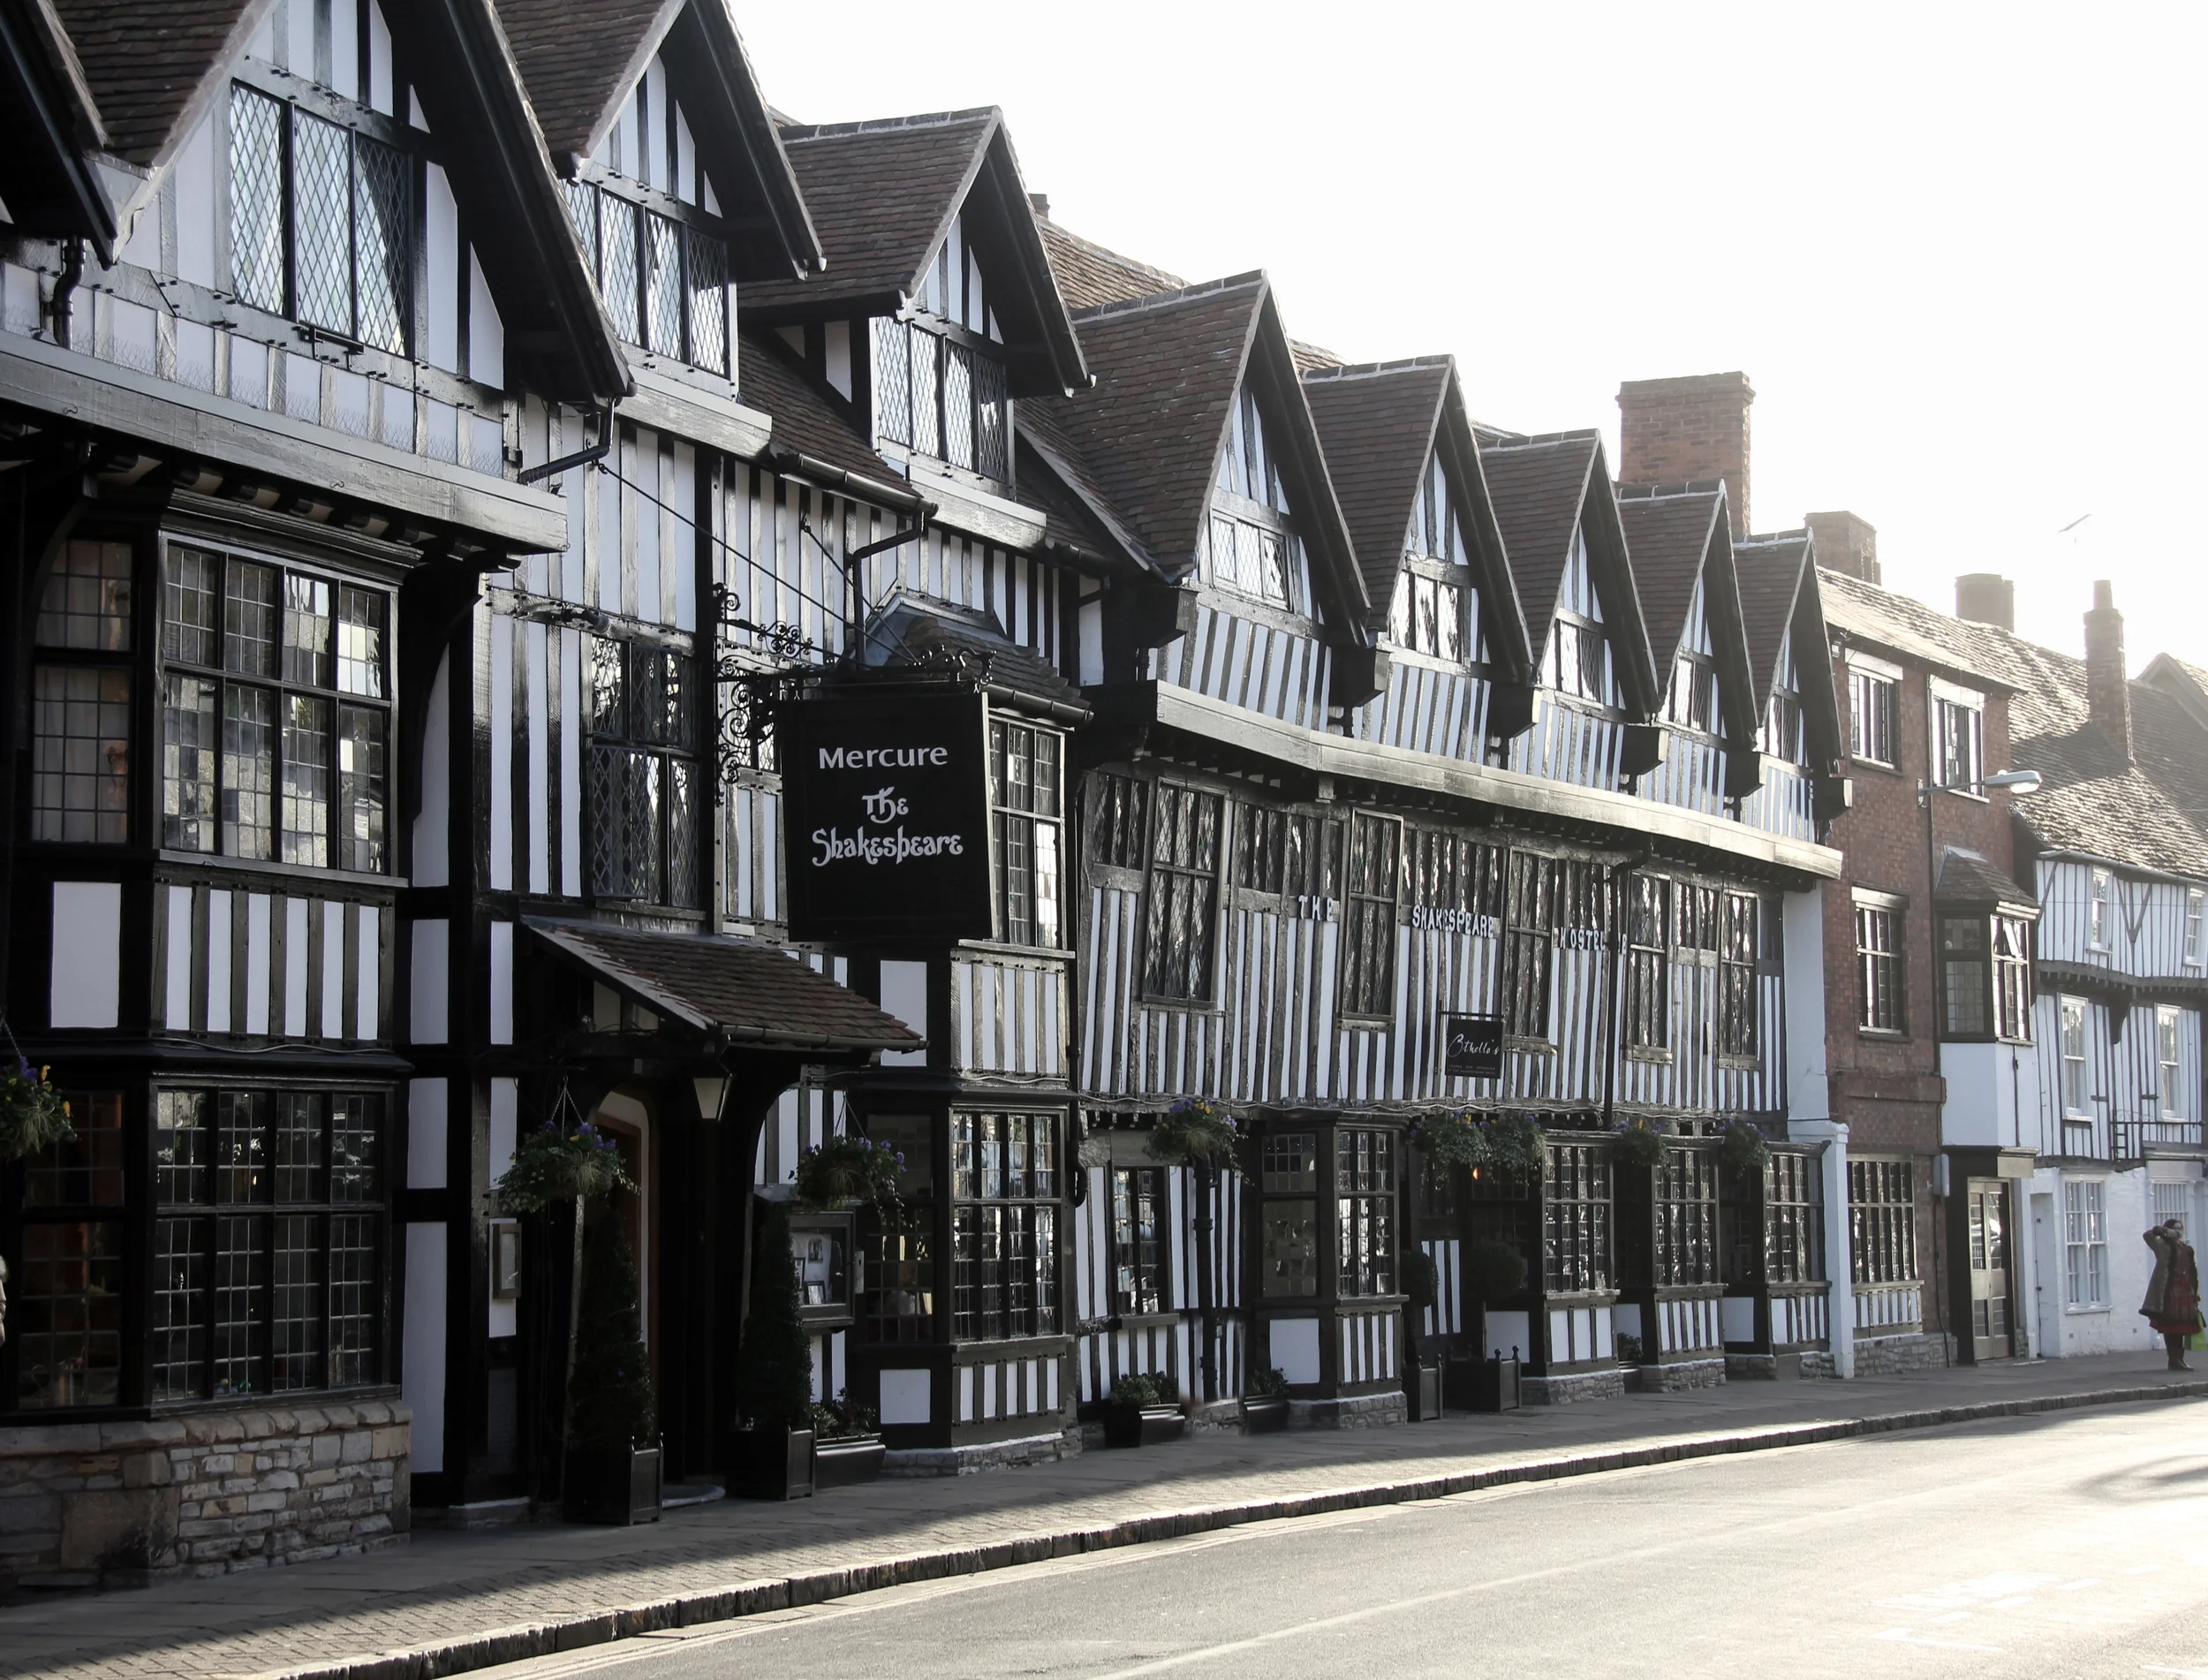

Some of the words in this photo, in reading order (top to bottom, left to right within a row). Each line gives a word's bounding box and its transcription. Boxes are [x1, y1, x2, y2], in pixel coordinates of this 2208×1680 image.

[819, 746, 948, 769] Mercure
[862, 786, 909, 823] The
[812, 825, 964, 866] Shakespeare
[1298, 895, 1334, 922] THE
[1412, 904, 1494, 938] SHAKESPEARE
[1560, 927, 1627, 955] HOSTELIE
[1448, 1033, 1500, 1057] Othello's
